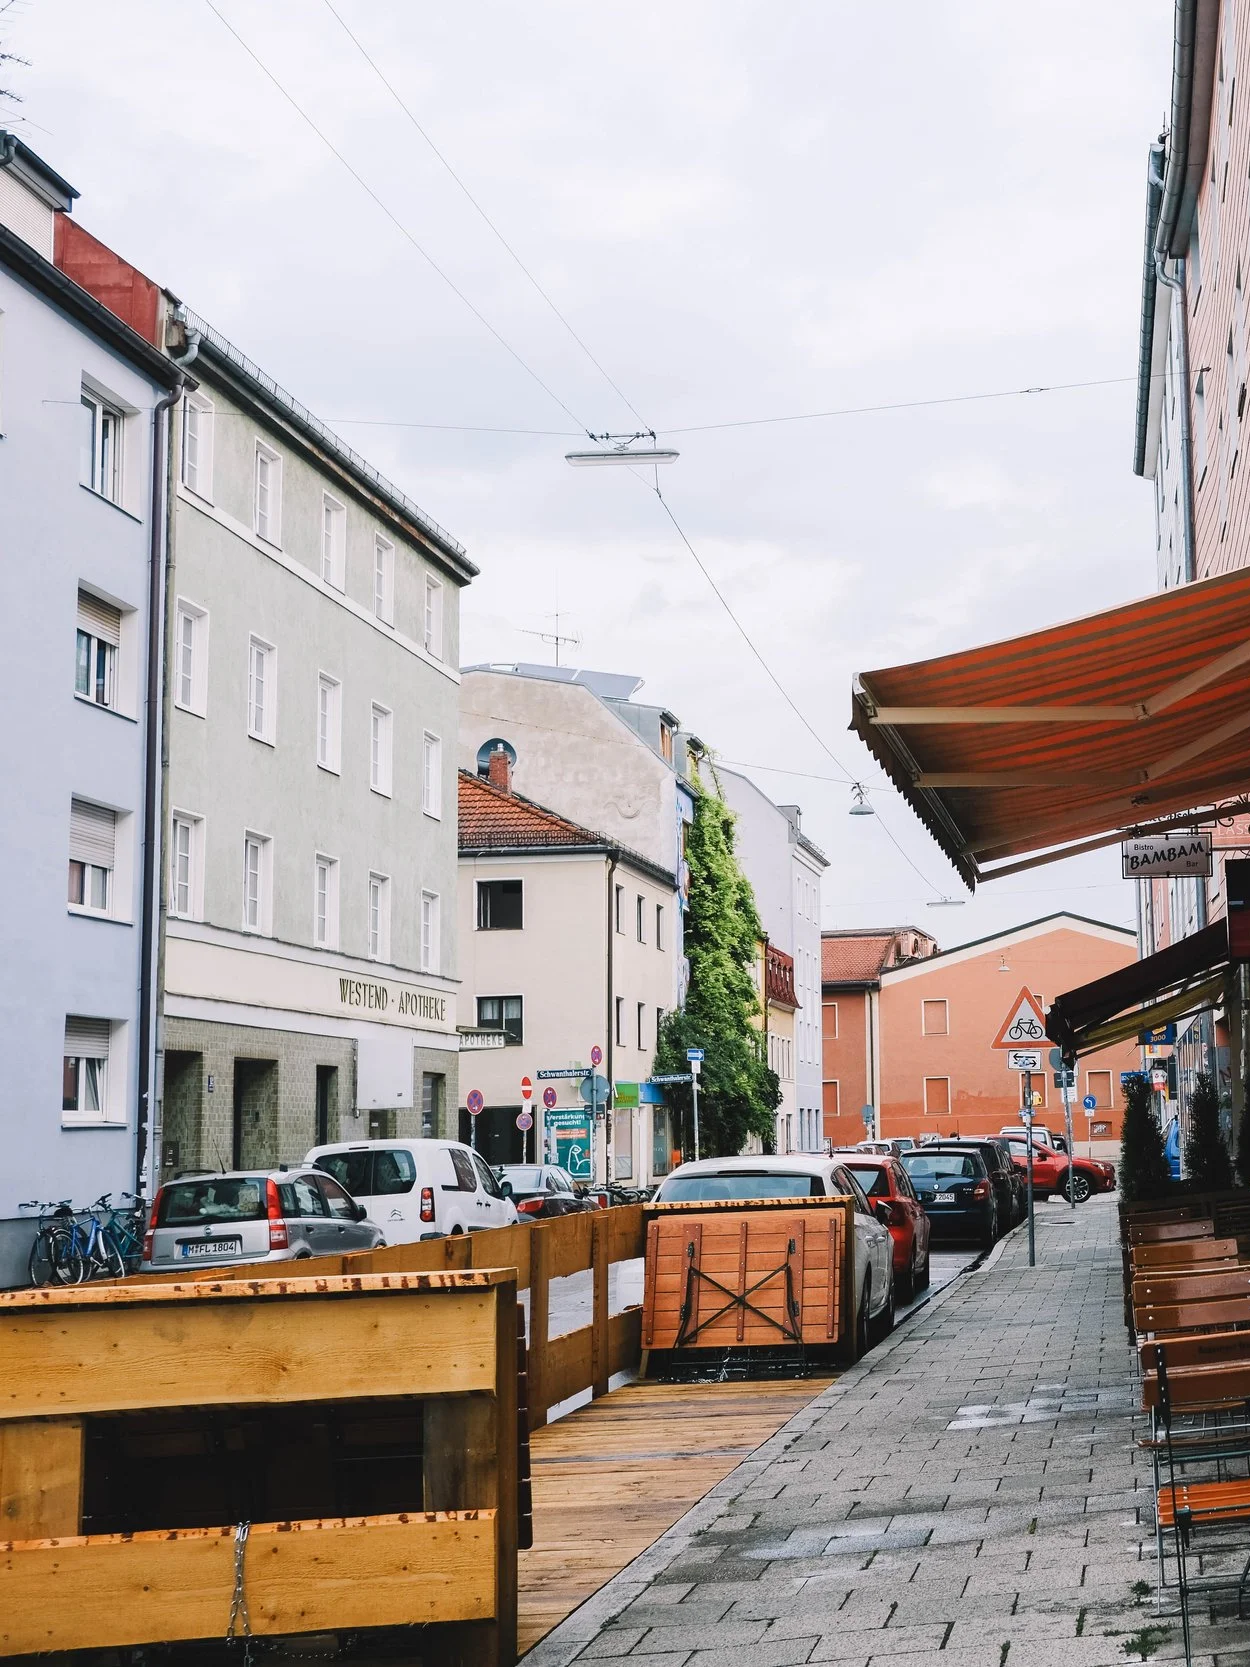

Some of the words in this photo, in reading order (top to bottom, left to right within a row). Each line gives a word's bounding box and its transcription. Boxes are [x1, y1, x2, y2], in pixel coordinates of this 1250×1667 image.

[1134, 843, 1154, 851] Bistro
[1130, 841, 1205, 870] BAMBAM
[1186, 860, 1199, 868] Bar
[339, 977, 388, 1011] WESTEND
[398, 990, 446, 1022] APOTHEKE
[459, 1033, 503, 1046] APOTHEKE
[212, 1242, 234, 1252] 1804
